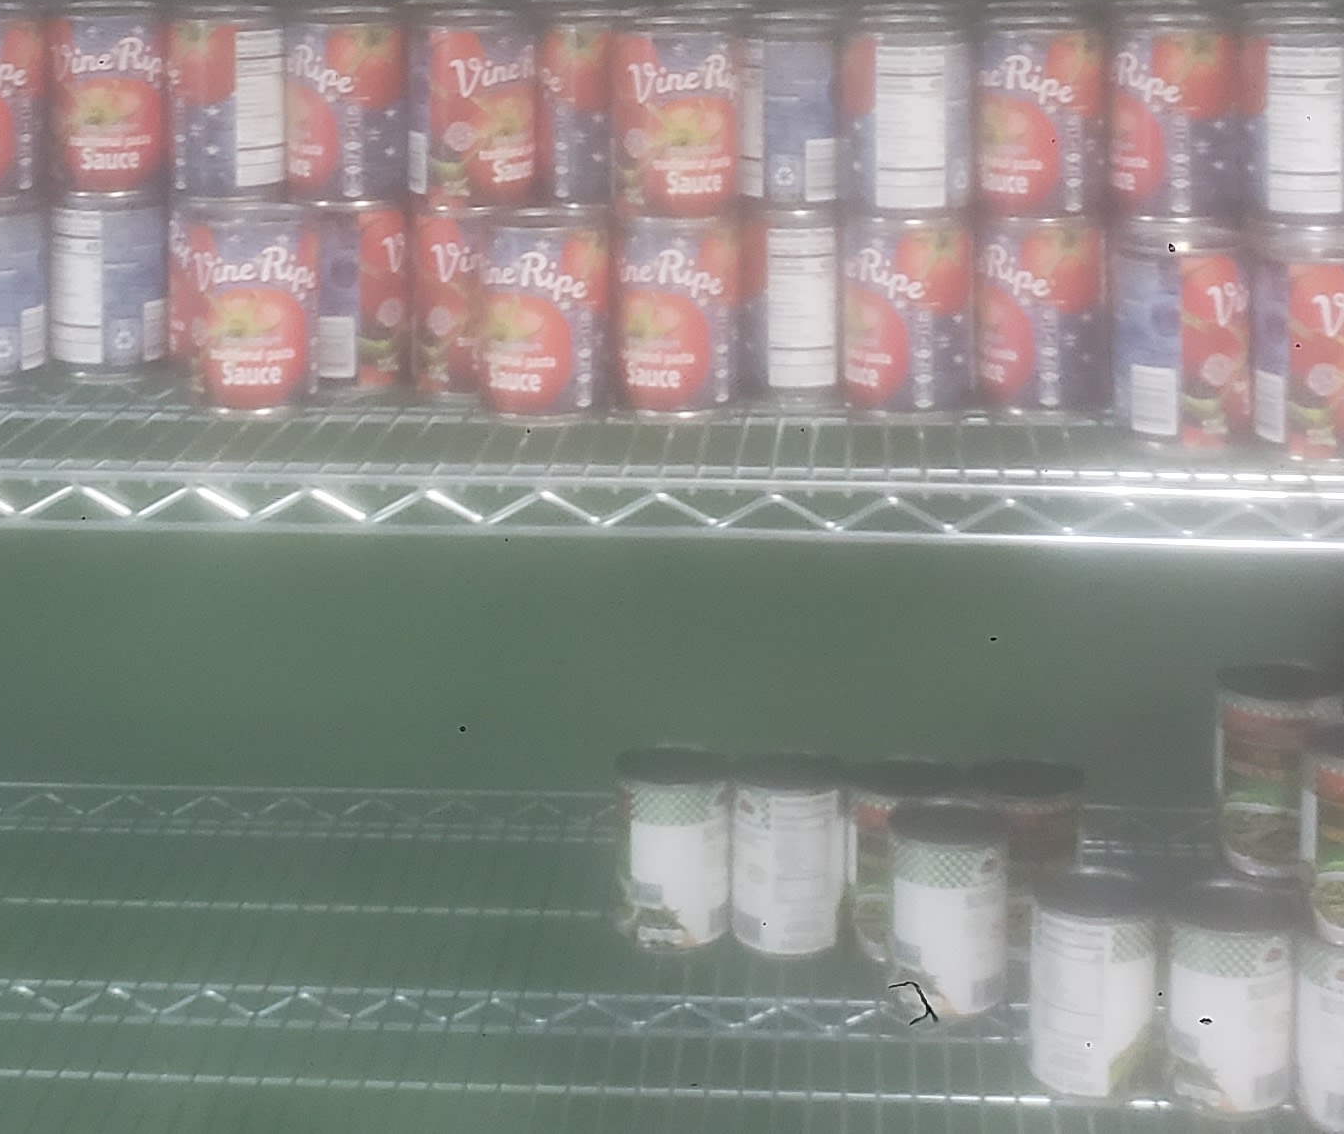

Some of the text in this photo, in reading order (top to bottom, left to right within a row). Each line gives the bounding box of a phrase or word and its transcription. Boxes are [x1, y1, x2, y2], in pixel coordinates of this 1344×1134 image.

[287, 44, 354, 94] Ripe
[627, 62, 702, 103] Vine
[1001, 54, 1075, 105] Ripe
[1115, 52, 1183, 103] Ripe
[81, 148, 140, 171] Sauce
[665, 171, 723, 195] Sauce
[193, 251, 257, 292] Vine
[518, 252, 589, 302] Ripe
[657, 249, 724, 298] Ripe
[857, 248, 927, 301] Ripe
[987, 245, 1054, 299] Ripe
[221, 362, 283, 386] Sauce
[626, 365, 682, 390] Sauce
